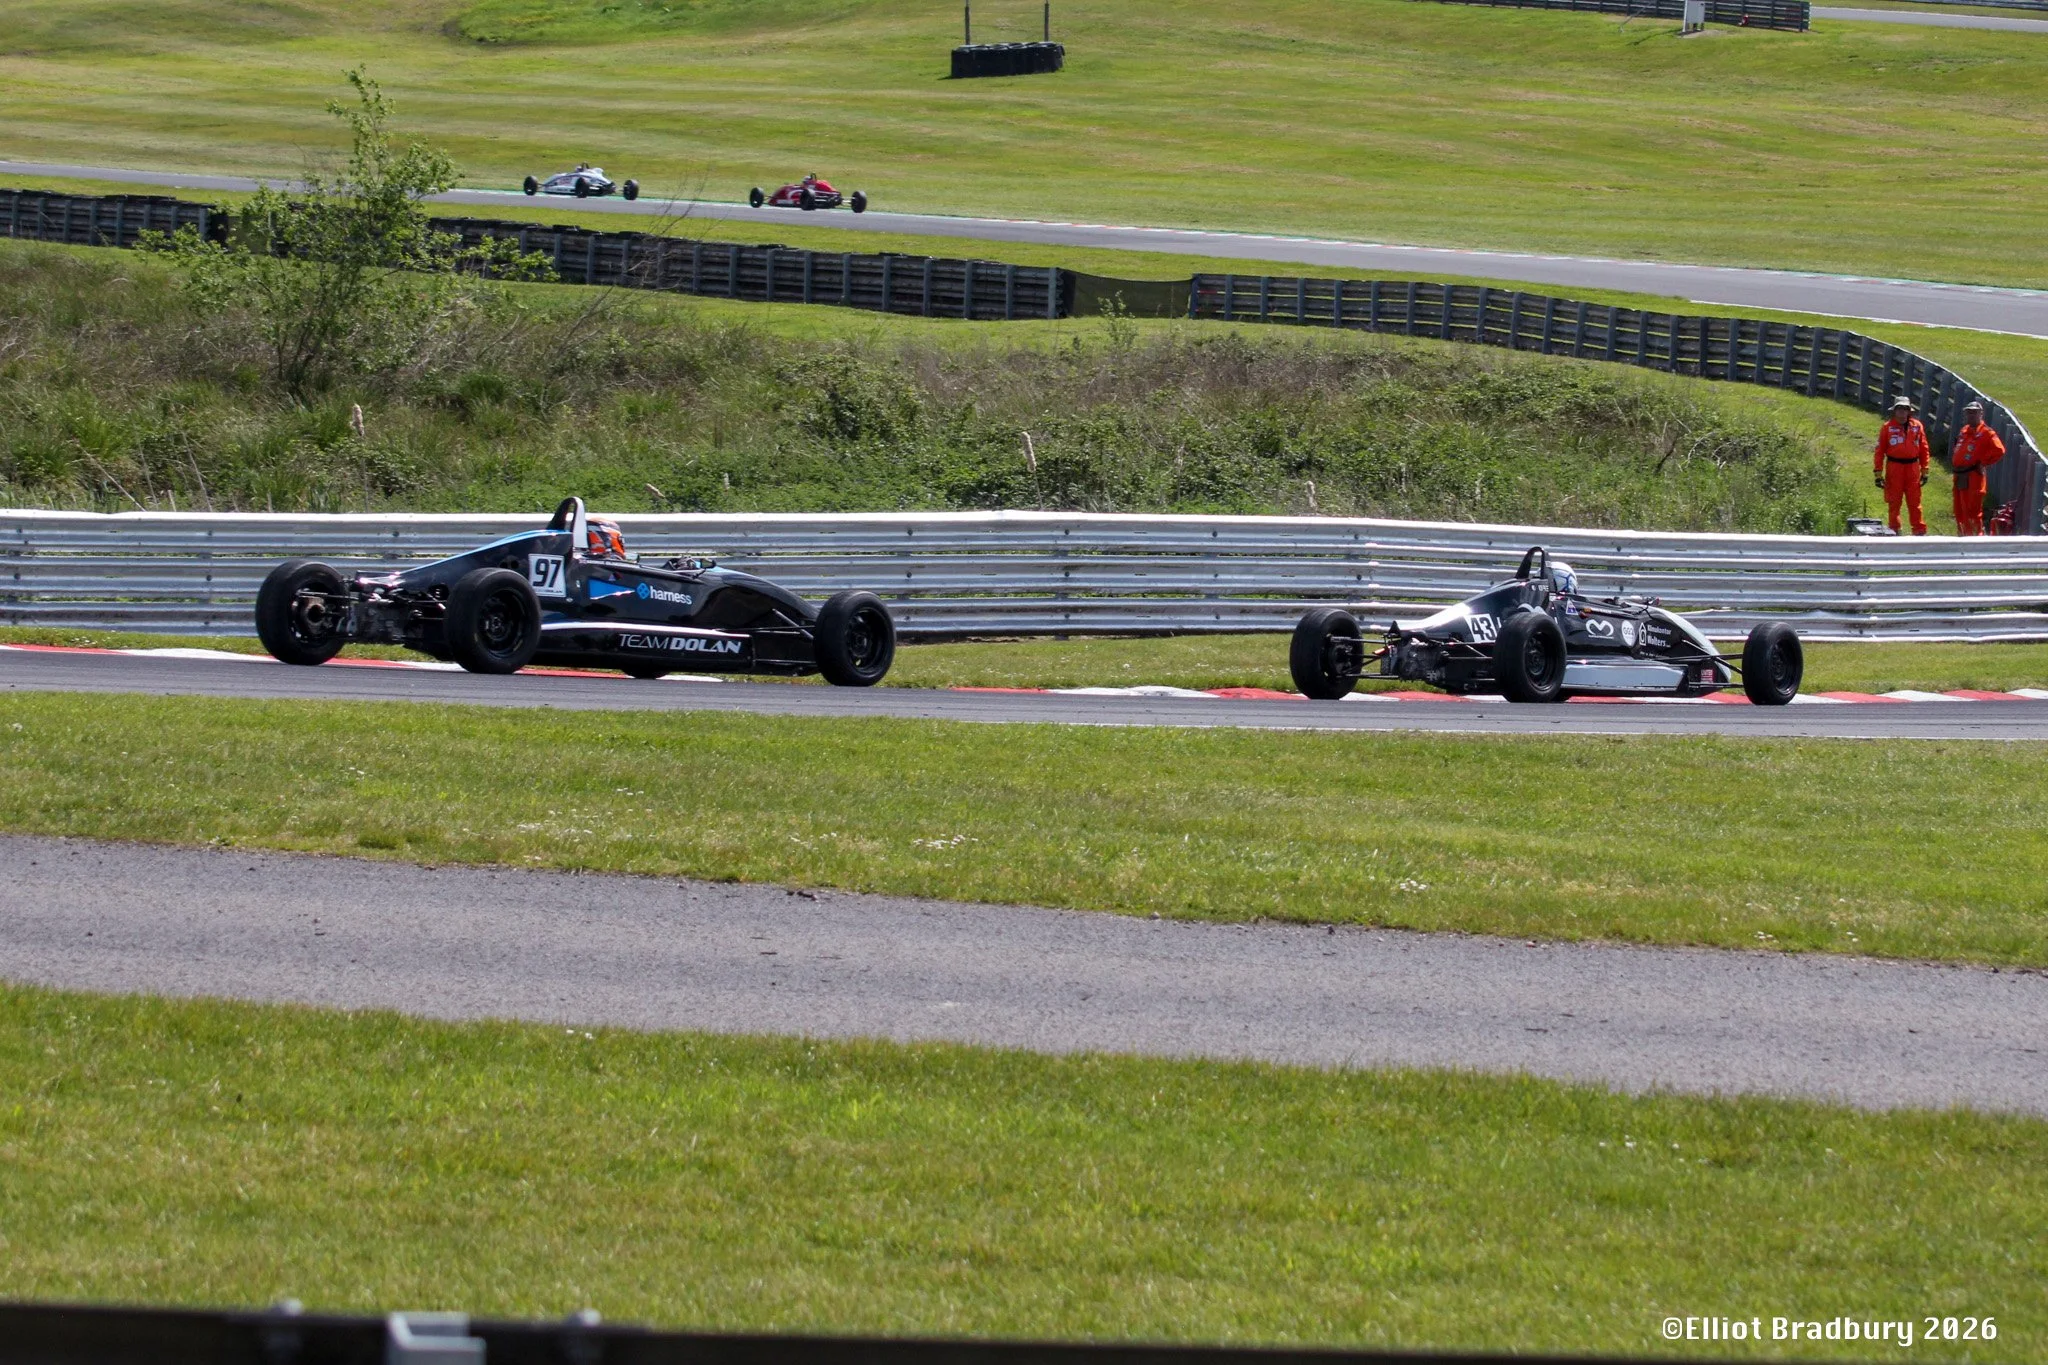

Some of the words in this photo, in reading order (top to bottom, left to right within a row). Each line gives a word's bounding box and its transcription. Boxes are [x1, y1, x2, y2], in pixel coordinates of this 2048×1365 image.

[533, 558, 562, 588] 97
[650, 585, 692, 605] harness
[1471, 617, 1497, 641] 43
[620, 633, 669, 649] TEAM
[670, 637, 741, 653] DOLAN
